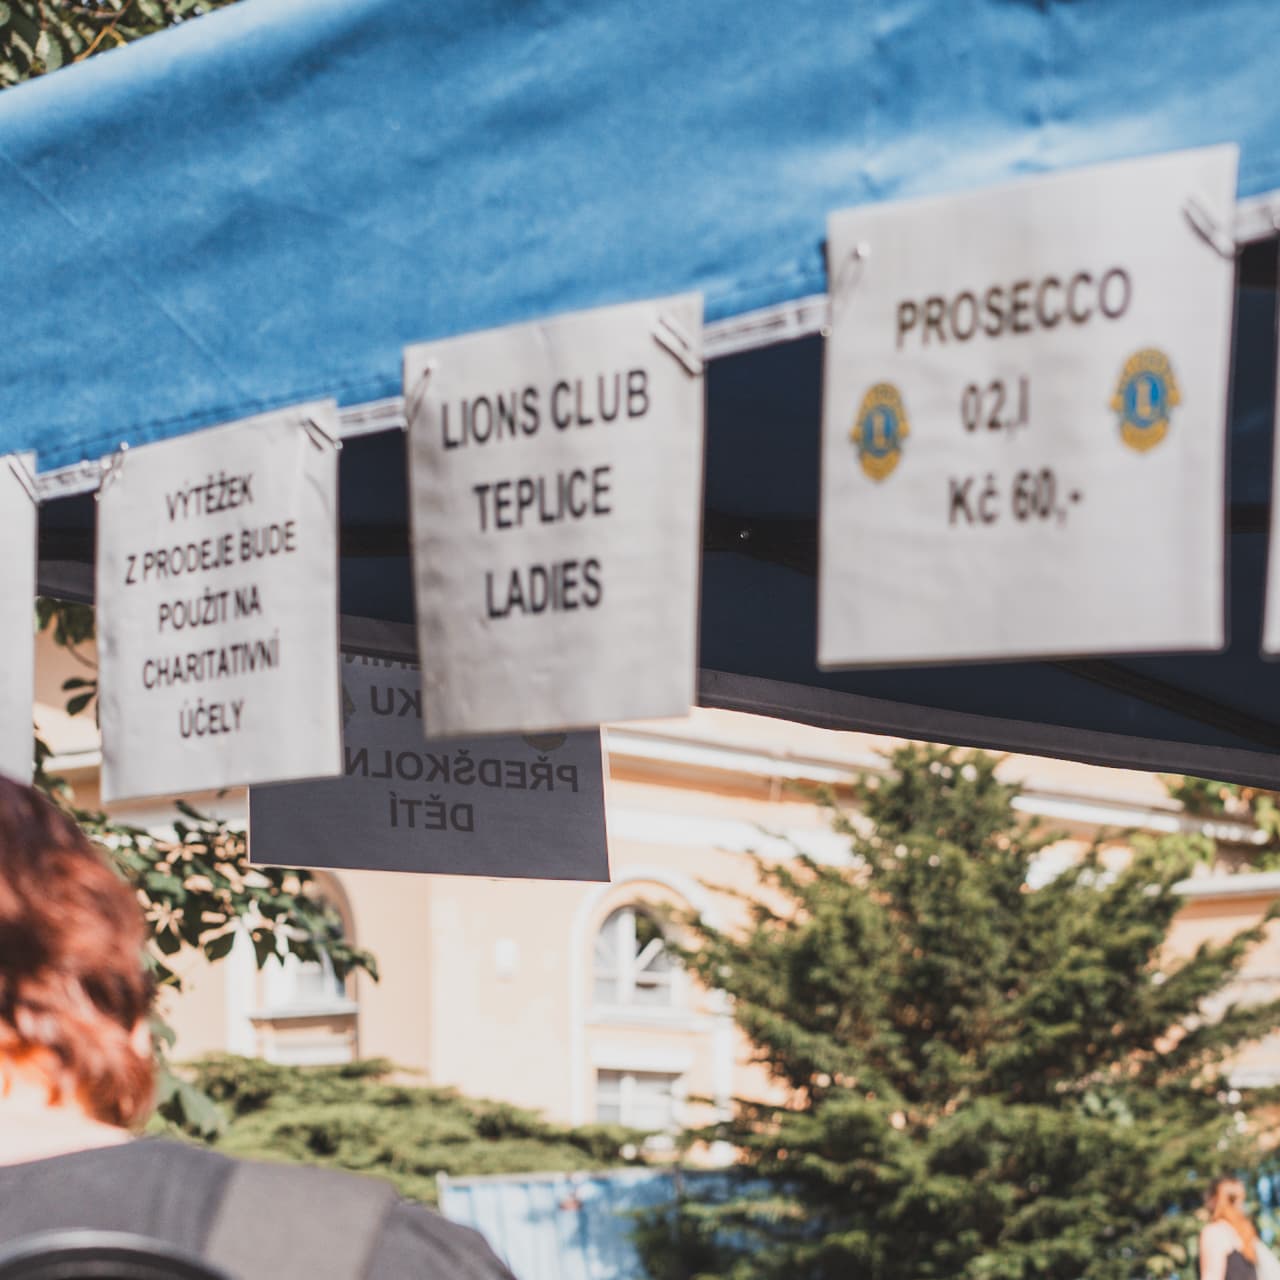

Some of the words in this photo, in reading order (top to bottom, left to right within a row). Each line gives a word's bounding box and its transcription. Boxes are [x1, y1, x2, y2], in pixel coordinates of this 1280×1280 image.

[895, 265, 1132, 351] PROSECCO
[441, 385, 540, 451] LIONS
[550, 369, 650, 431] CLUB
[165, 471, 254, 522] VÝTĚŽEK
[472, 465, 612, 532] TEPLICE
[948, 474, 998, 528] Kč
[1011, 467, 1083, 529] 60,-
[125, 554, 138, 586] Z
[143, 533, 234, 582] PRODEJE
[240, 521, 297, 563] BUDE
[234, 584, 262, 619] NA
[486, 558, 603, 620] LADIES
[179, 697, 244, 738] ÚČELY
